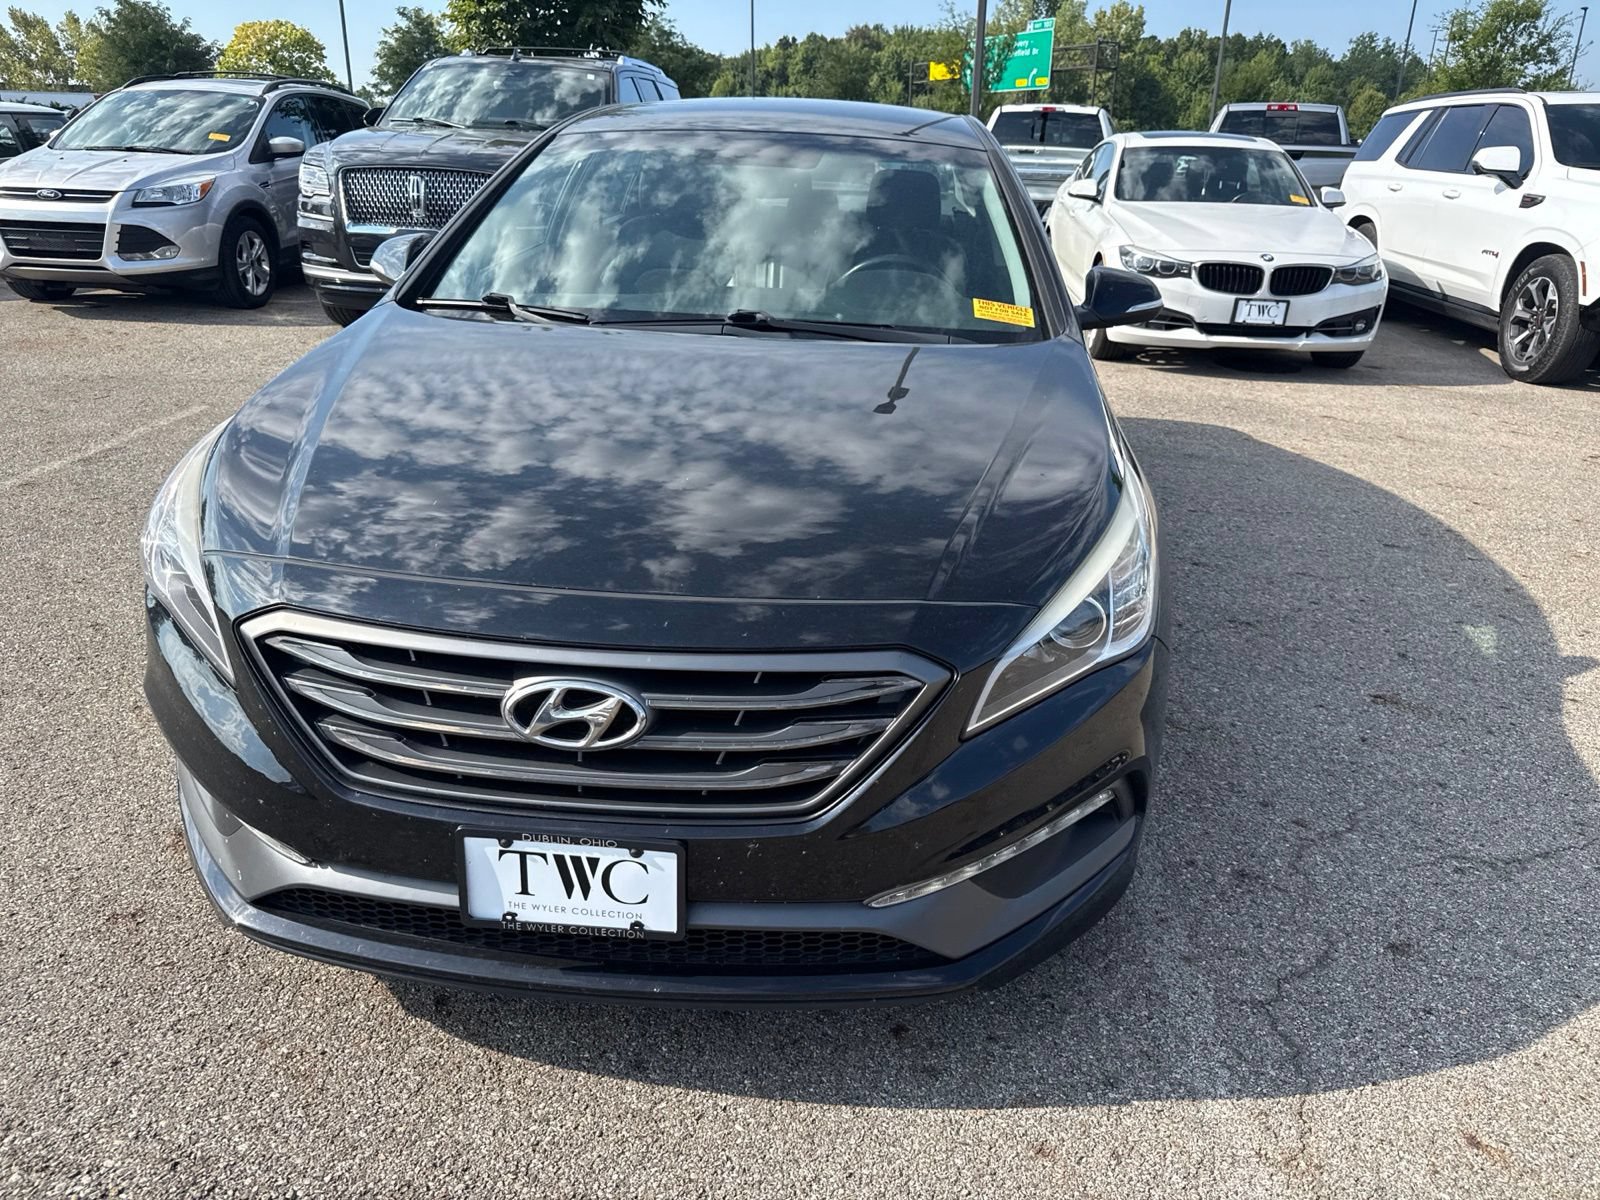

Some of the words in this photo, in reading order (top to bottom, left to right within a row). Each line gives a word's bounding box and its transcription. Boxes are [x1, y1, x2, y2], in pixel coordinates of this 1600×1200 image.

[997, 303, 1029, 312] VEHICLE
[1245, 304, 1280, 318] TWC
[580, 837, 618, 848] OHIO
[498, 849, 649, 906] TWC
[508, 901, 527, 910] THE
[532, 903, 567, 914] WYLER
[572, 907, 643, 920] COLLECTION
[501, 921, 522, 931] THE
[527, 923, 564, 934] WYLER
[569, 926, 645, 939] COLLECTION
